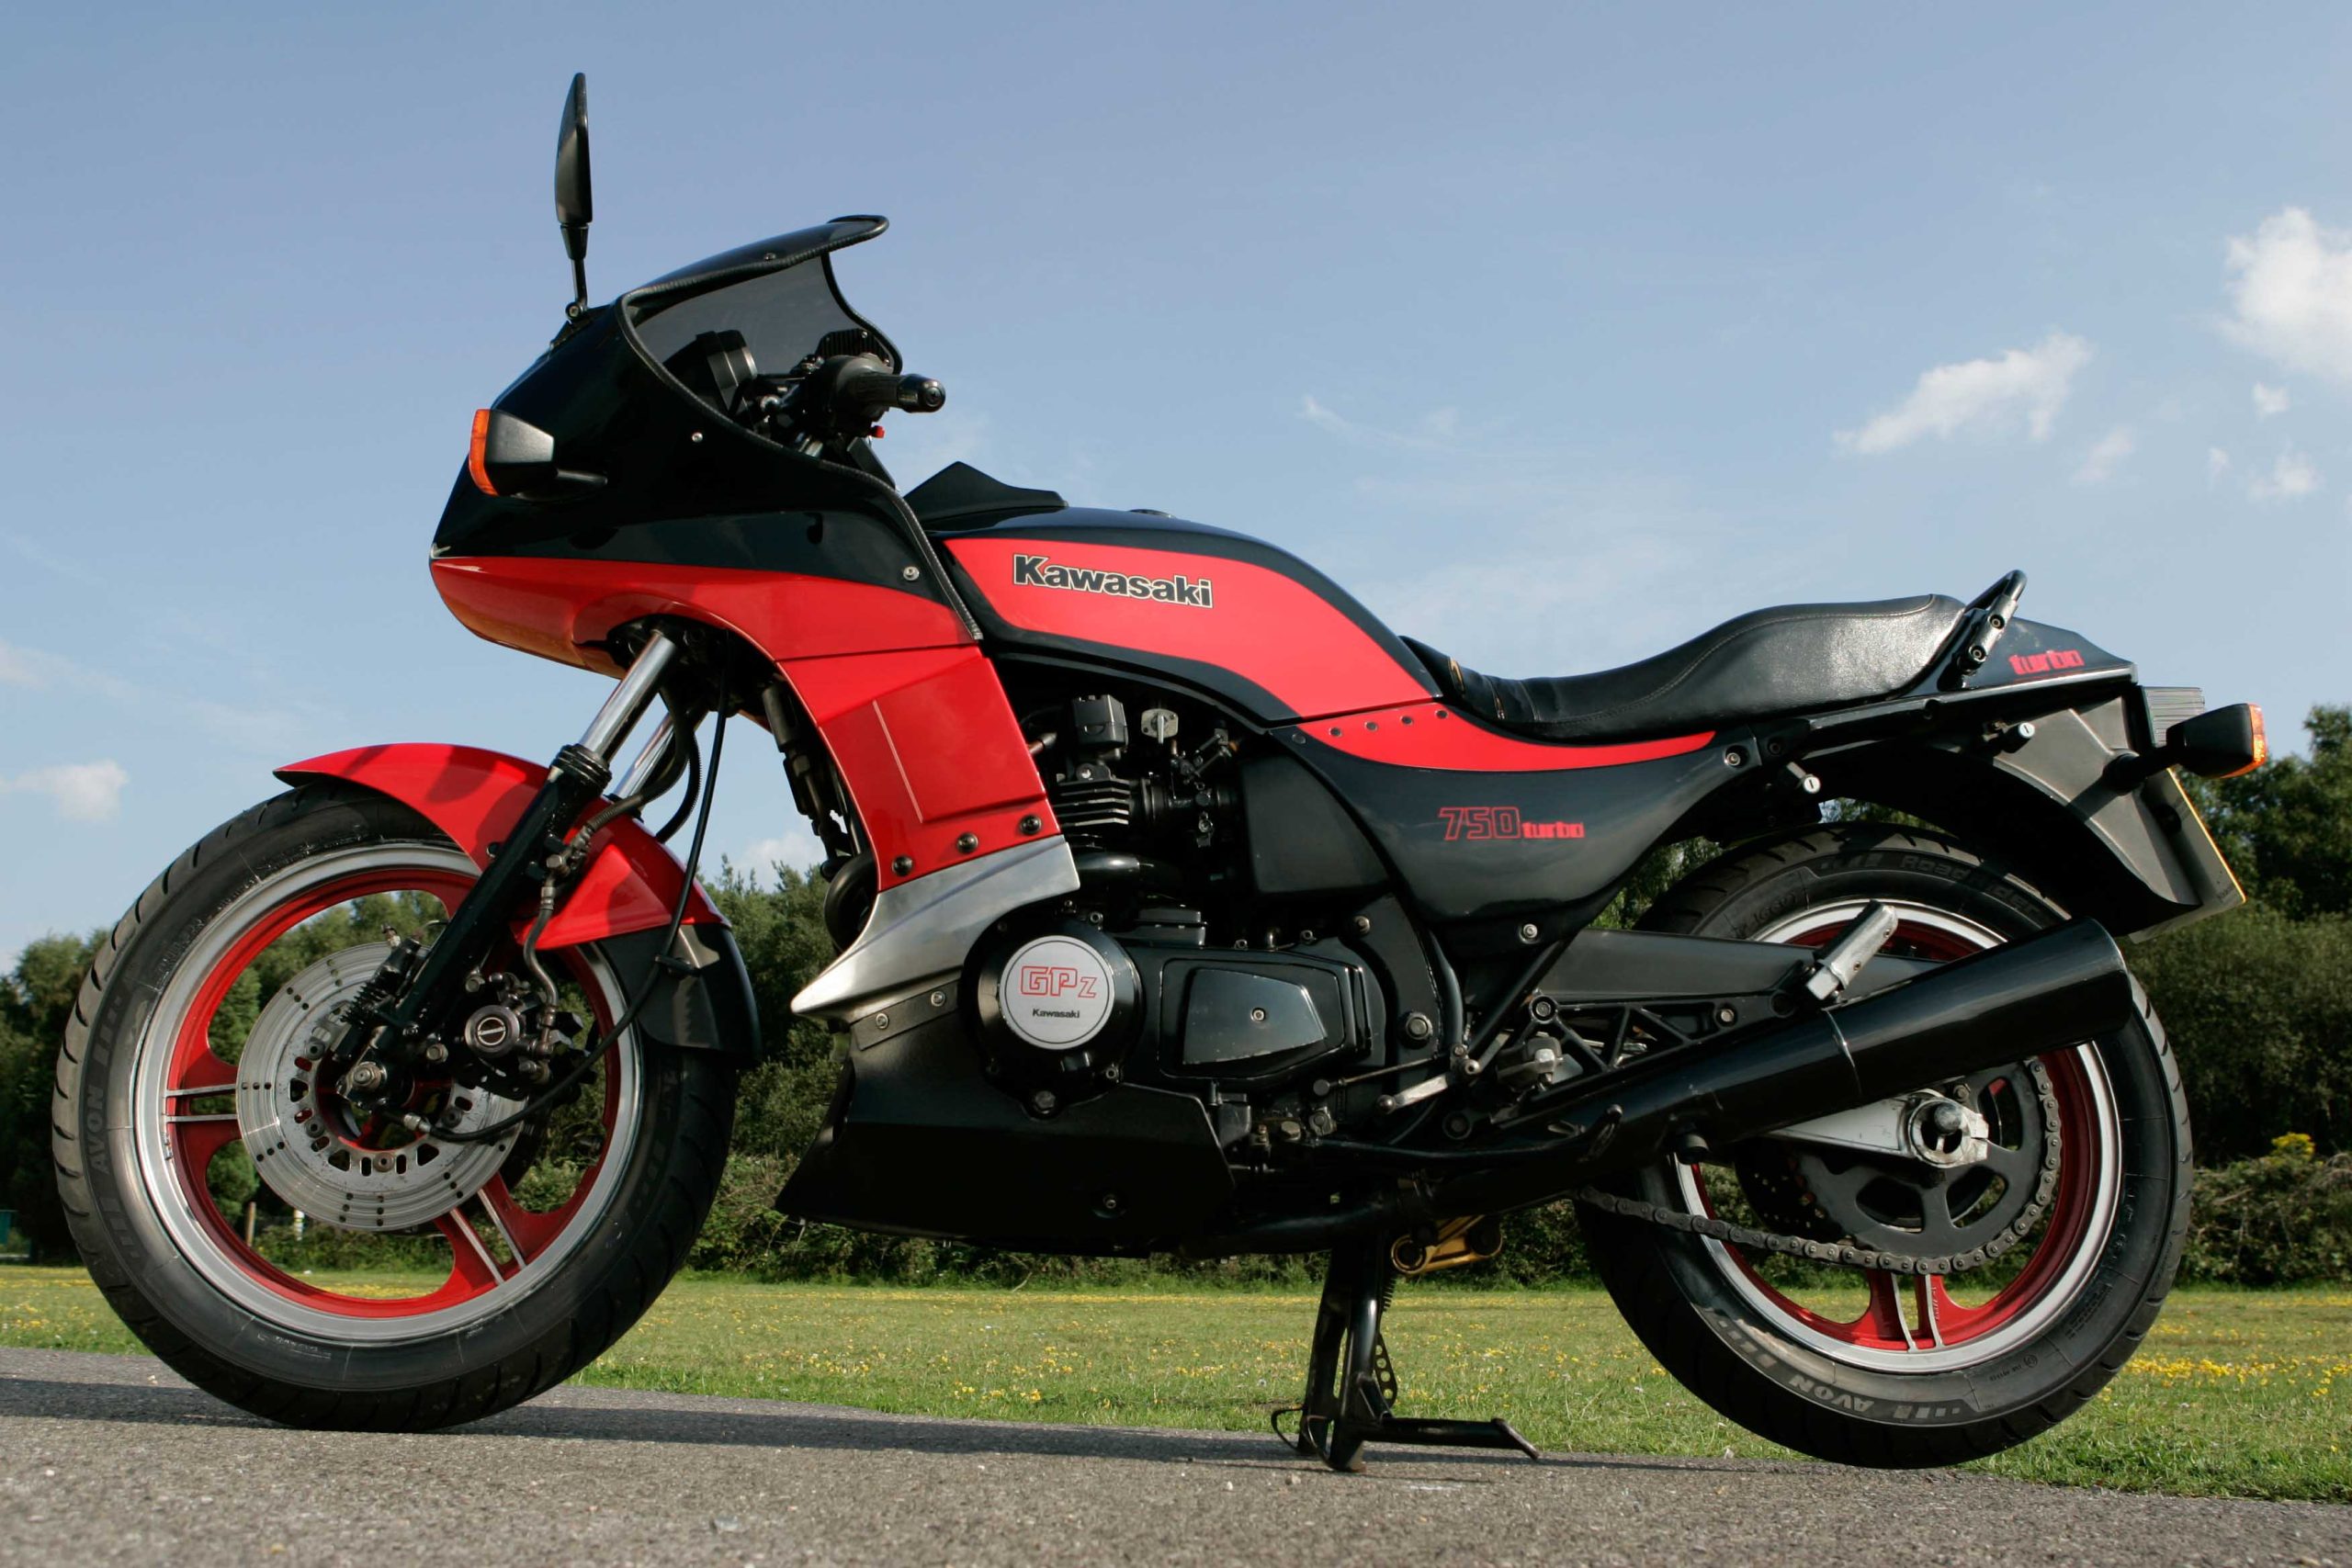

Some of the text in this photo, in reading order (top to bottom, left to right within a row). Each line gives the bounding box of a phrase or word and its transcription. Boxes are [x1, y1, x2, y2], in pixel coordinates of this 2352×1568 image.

[1013, 553, 1214, 608] Kawasaki
[2007, 649, 2086, 676] turbo
[1438, 806, 1586, 841] 750 turbo
[1021, 965, 1098, 998] GPz
[1032, 1008, 1080, 1019] Kawasaki
[86, 1087, 109, 1176] AVON
[1788, 1374, 1875, 1412] AVON
